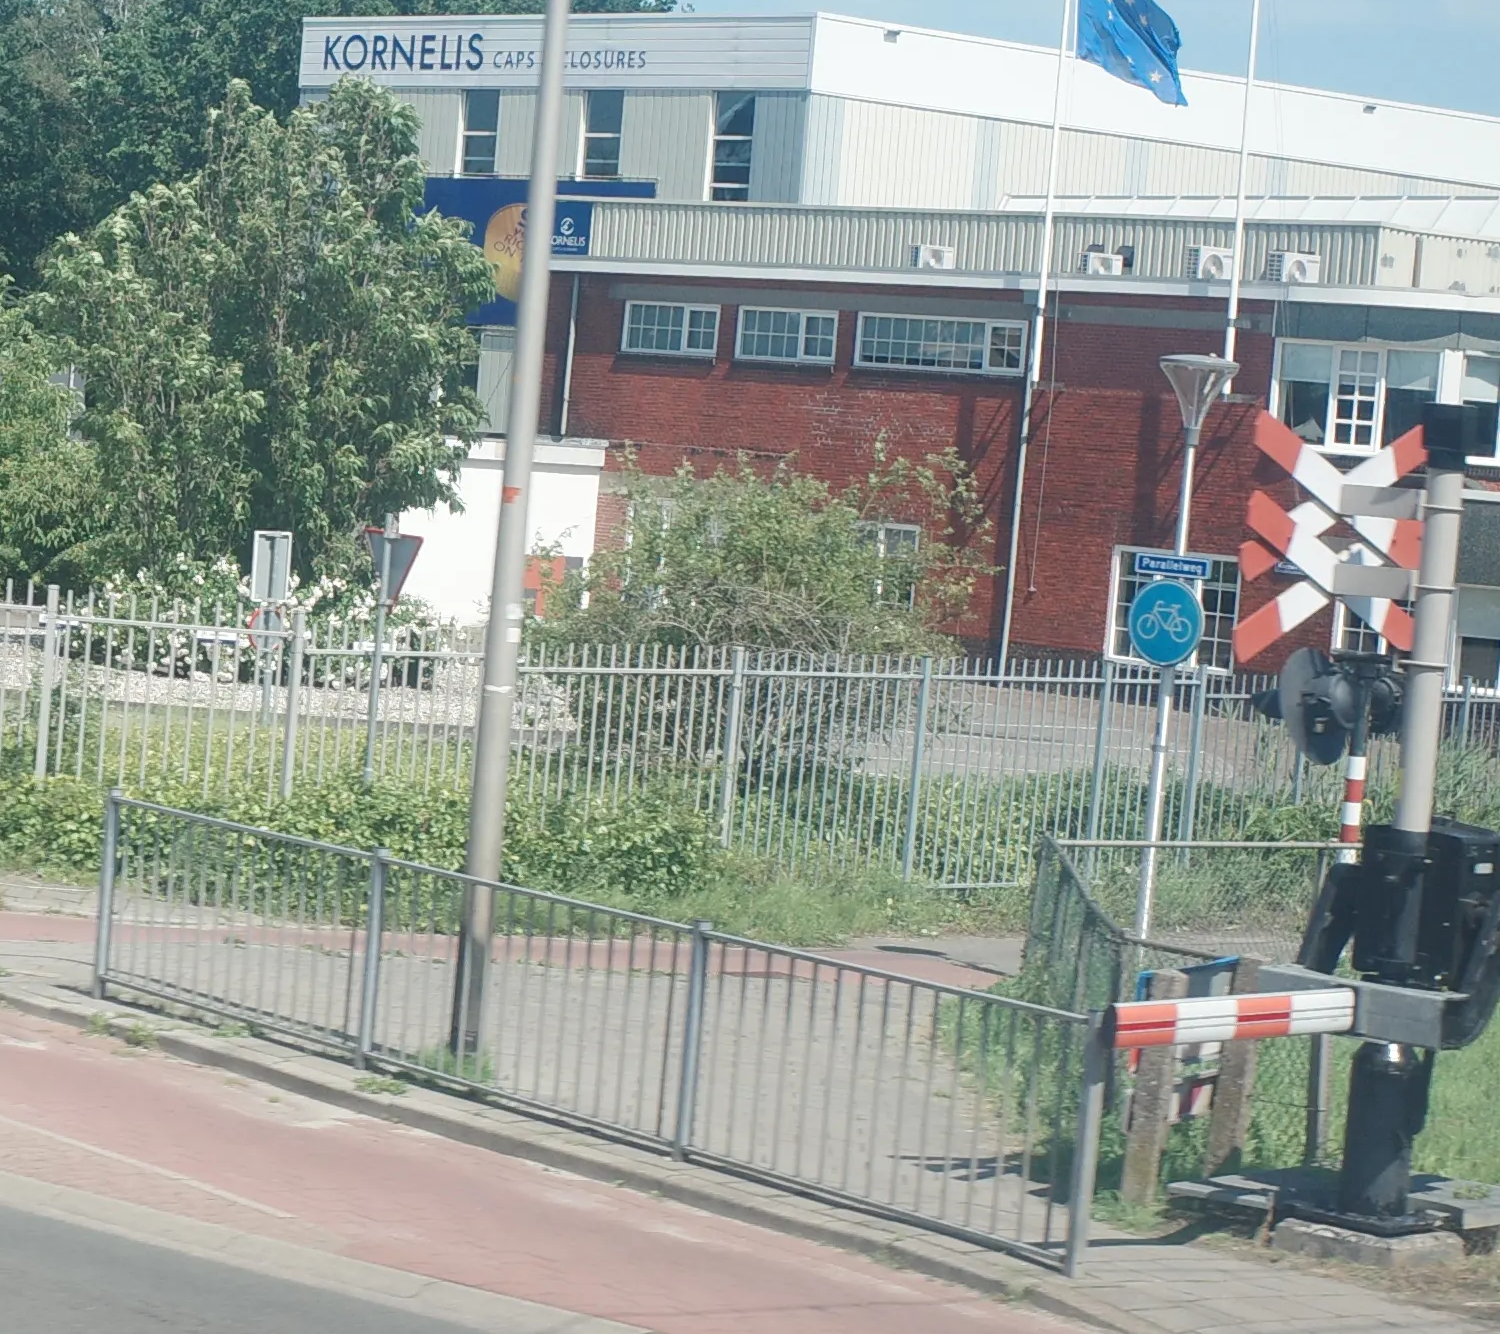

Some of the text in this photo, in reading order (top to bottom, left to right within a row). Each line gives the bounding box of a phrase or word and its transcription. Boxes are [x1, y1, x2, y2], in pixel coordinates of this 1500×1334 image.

[322, 33, 484, 72] KORNELIS
[492, 51, 535, 69] CAPS
[550, 235, 586, 247] ORNELIS
[1142, 556, 1203, 576] Parallelweg
